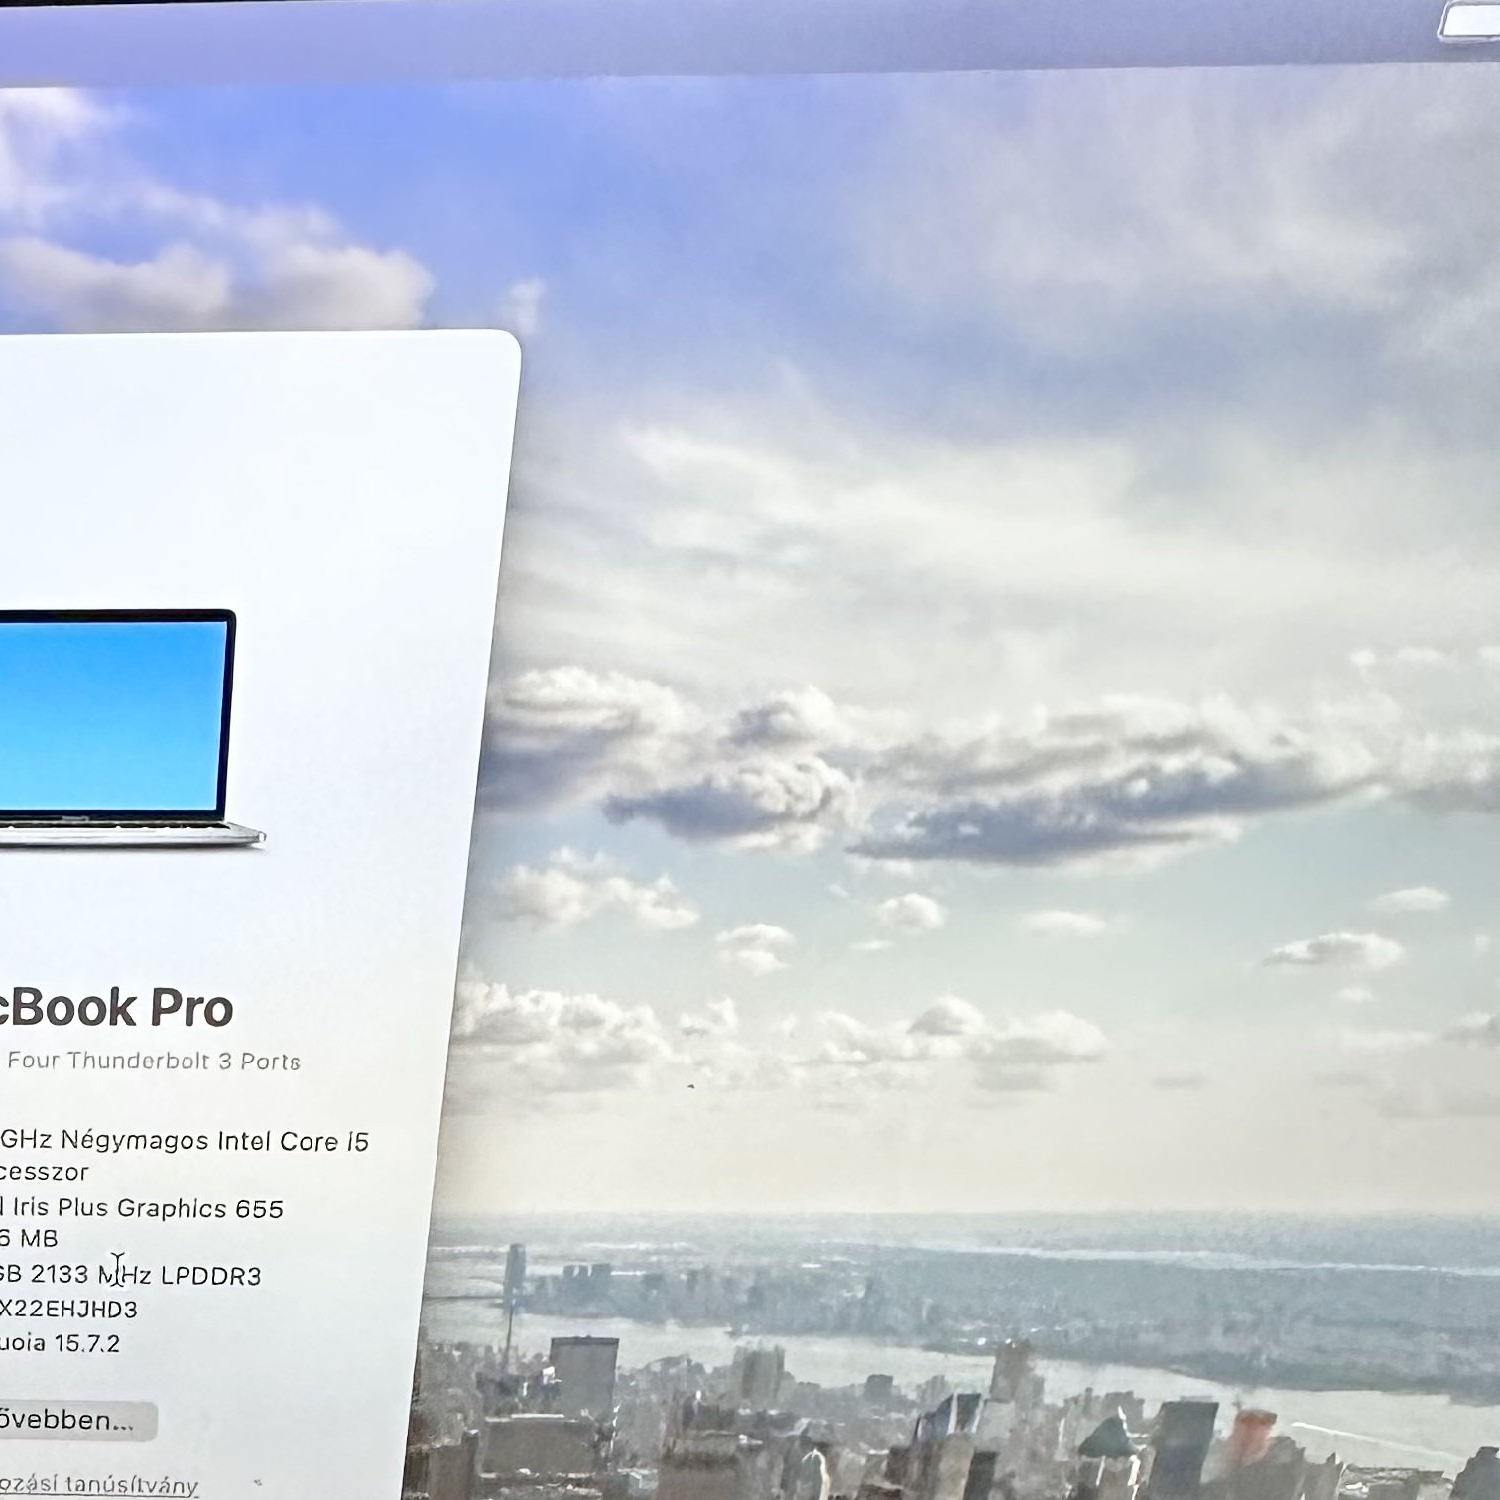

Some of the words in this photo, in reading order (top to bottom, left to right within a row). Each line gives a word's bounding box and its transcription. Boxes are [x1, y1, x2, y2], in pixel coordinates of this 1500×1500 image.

[152, 987, 233, 1027] Pro
[9, 1051, 60, 1069] Four
[67, 1051, 209, 1069] Thunderbolt
[219, 1053, 231, 1070] 3
[242, 1053, 300, 1070] Ports
[0, 1128, 52, 1149] GHz
[62, 1128, 208, 1154] Négymagos
[219, 1130, 270, 1151] Intel
[281, 1131, 338, 1152] Core
[348, 1131, 369, 1152] i5
[14, 1196, 49, 1216] Iris
[59, 1197, 108, 1216] Plus
[118, 1197, 226, 1222] Graphics
[236, 1200, 283, 1218] 655
[21, 1229, 58, 1248] MB
[32, 1264, 88, 1284] 2133
[162, 1266, 261, 1286] LPDDR3
[56, 1334, 119, 1352] 15.7.2
